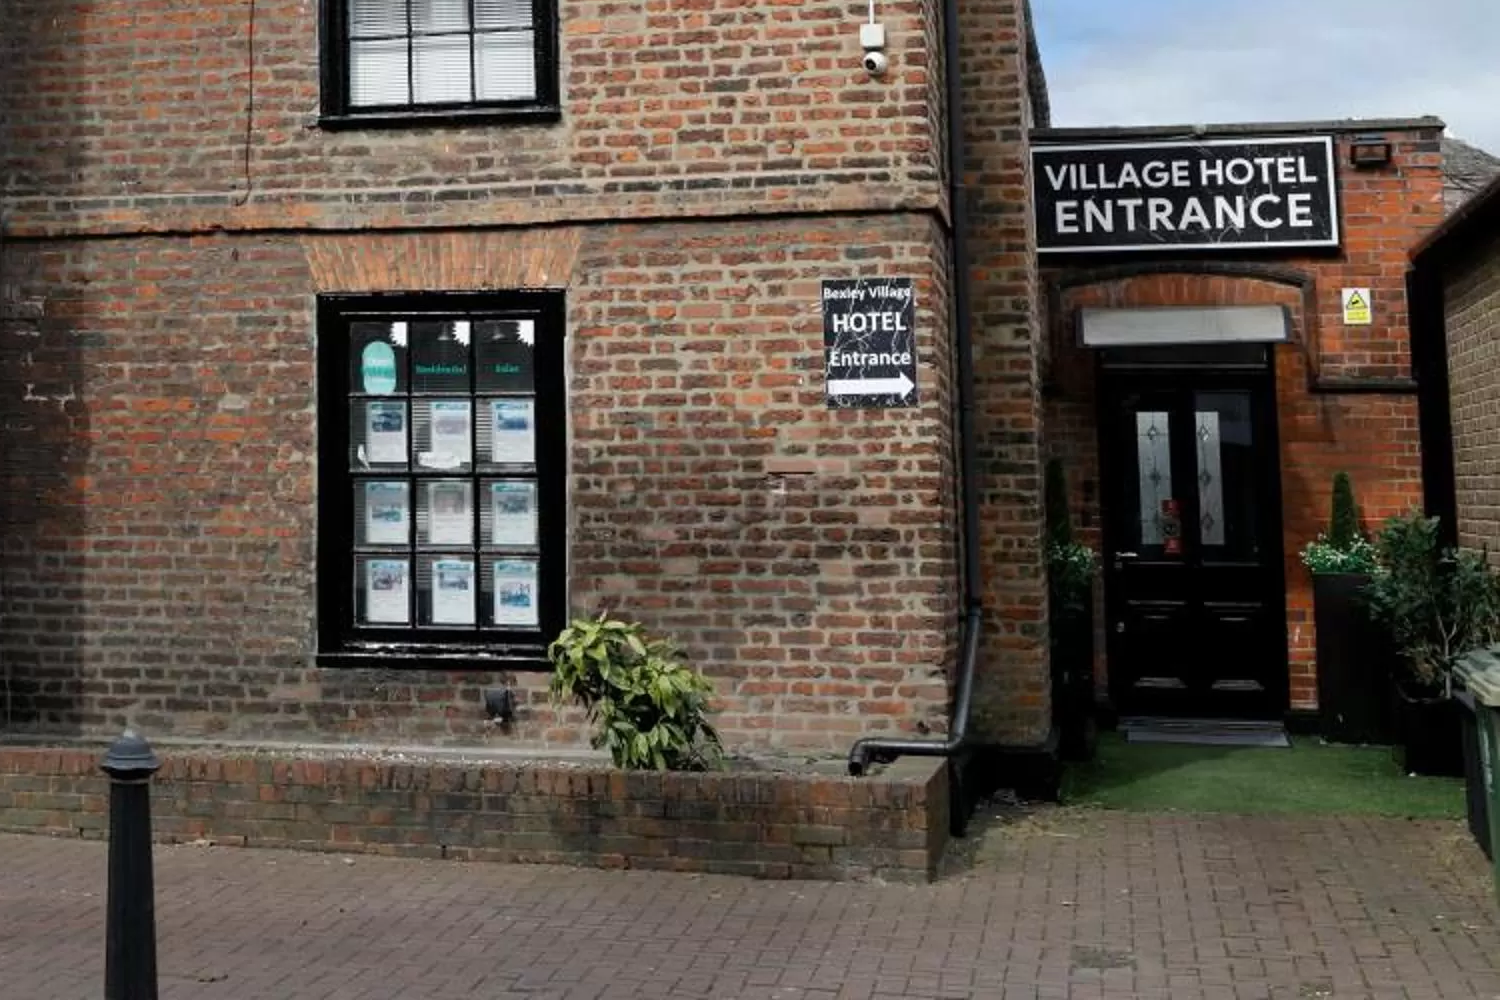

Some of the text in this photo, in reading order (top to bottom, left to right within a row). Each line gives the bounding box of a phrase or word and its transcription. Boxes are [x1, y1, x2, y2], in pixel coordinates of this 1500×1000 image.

[1044, 156, 1317, 191] VILLAGE HOTEL
[1055, 193, 1314, 234] ENTRANCE
[823, 286, 911, 301] Bexley Village
[832, 311, 907, 333] HOTEL
[830, 350, 911, 367] Entrance
